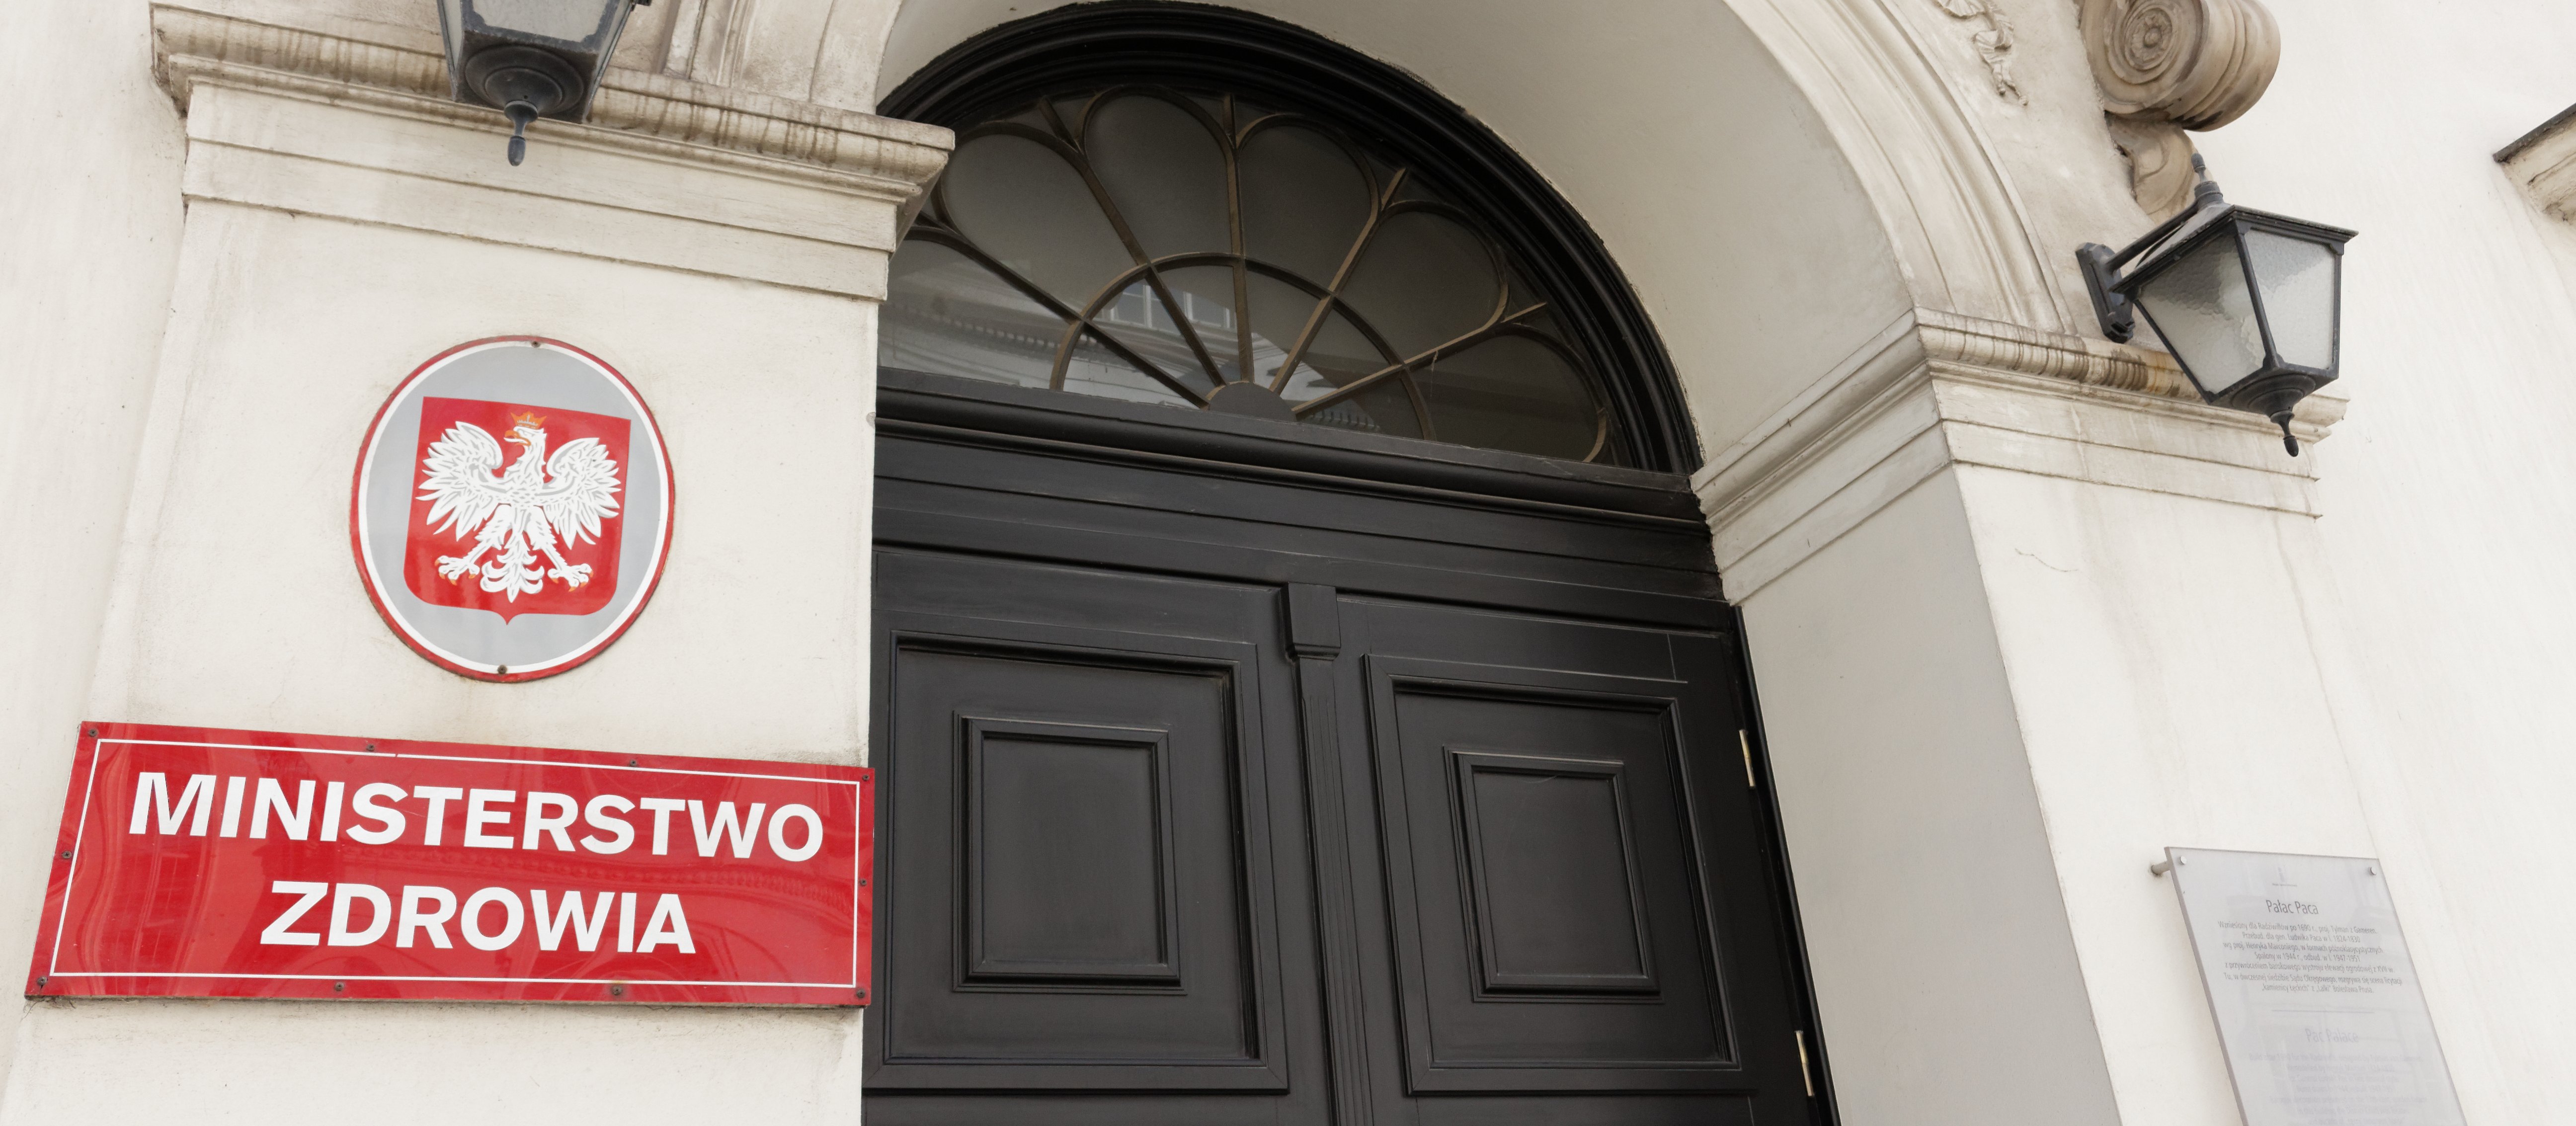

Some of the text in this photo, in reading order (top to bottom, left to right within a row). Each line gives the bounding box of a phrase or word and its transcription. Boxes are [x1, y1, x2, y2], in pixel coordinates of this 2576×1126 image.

[129, 772, 823, 861] MINISTERSTWO
[2265, 899, 2319, 914] Pałac Paca
[260, 881, 696, 954] ZDROWIA
[2218, 921, 2248, 931] Wzniesiony
[2331, 925, 2349, 934] Tylman
[2245, 942, 2267, 951] Henryka
[2267, 942, 2300, 952] Marconiego,
[2254, 952, 2275, 962] Spalony
[2268, 962, 2301, 971] barokowego
[2301, 964, 2324, 972] wystroju
[2324, 964, 2345, 973] elewacji
[2345, 965, 2373, 974] ogrodowej
[2290, 973, 2303, 984] Sądu
[2361, 976, 2370, 984] się
[2332, 984, 2358, 993] Bolesława
[2305, 1027, 2359, 1043] Pac Palace
